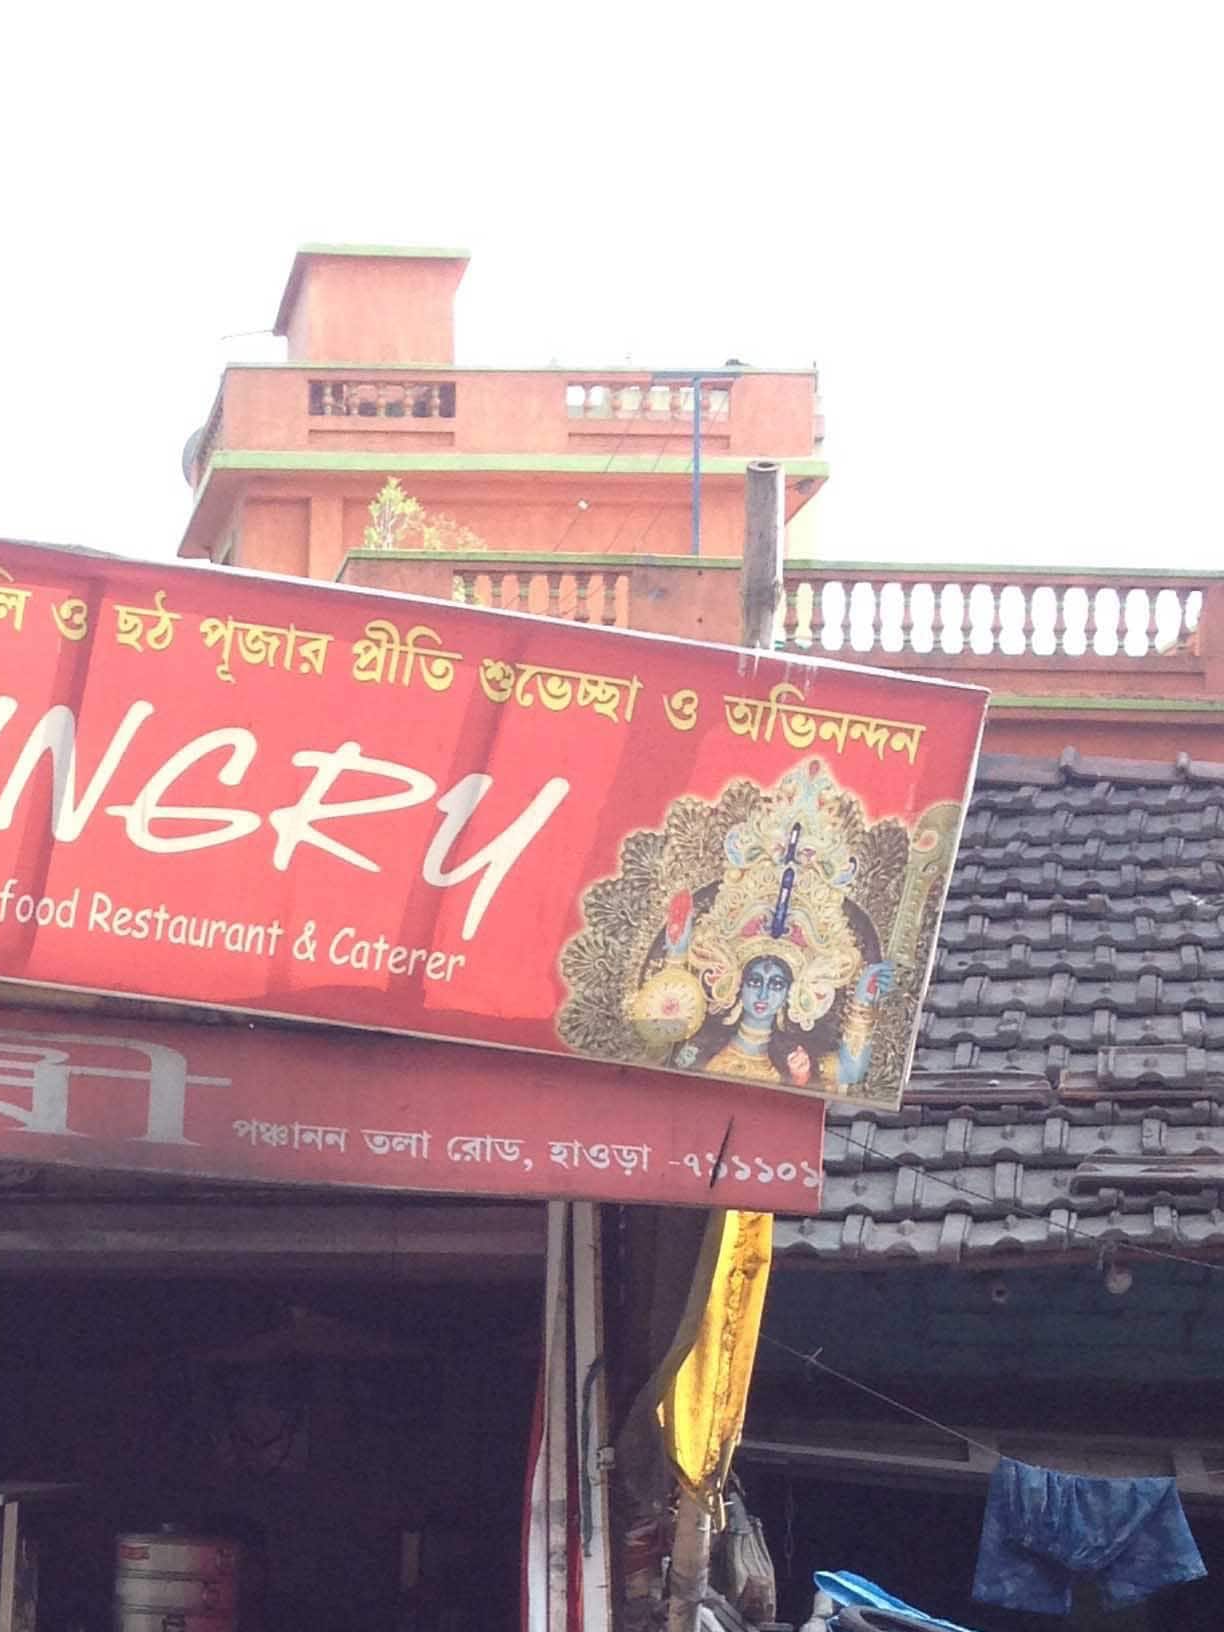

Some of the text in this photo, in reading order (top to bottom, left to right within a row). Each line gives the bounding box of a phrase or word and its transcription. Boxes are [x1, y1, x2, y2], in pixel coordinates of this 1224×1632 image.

[51, 597, 88, 641] ও
[113, 590, 182, 653] ছঠ
[199, 615, 334, 683] পূজার
[352, 619, 464, 692] প্রীতি
[479, 658, 643, 723] শুভেচ্ছা
[662, 688, 699, 731] ও
[723, 682, 926, 766] অভিনন্দন
[87, 891, 285, 957] Restaurant
[290, 920, 318, 962] &
[327, 926, 468, 983] Caterer
[232, 1118, 349, 1153] পঞ্চানন
[361, 1128, 432, 1161] তলা
[447, 1134, 534, 1172] রোড,
[548, 1139, 653, 1177] হাওড়া
